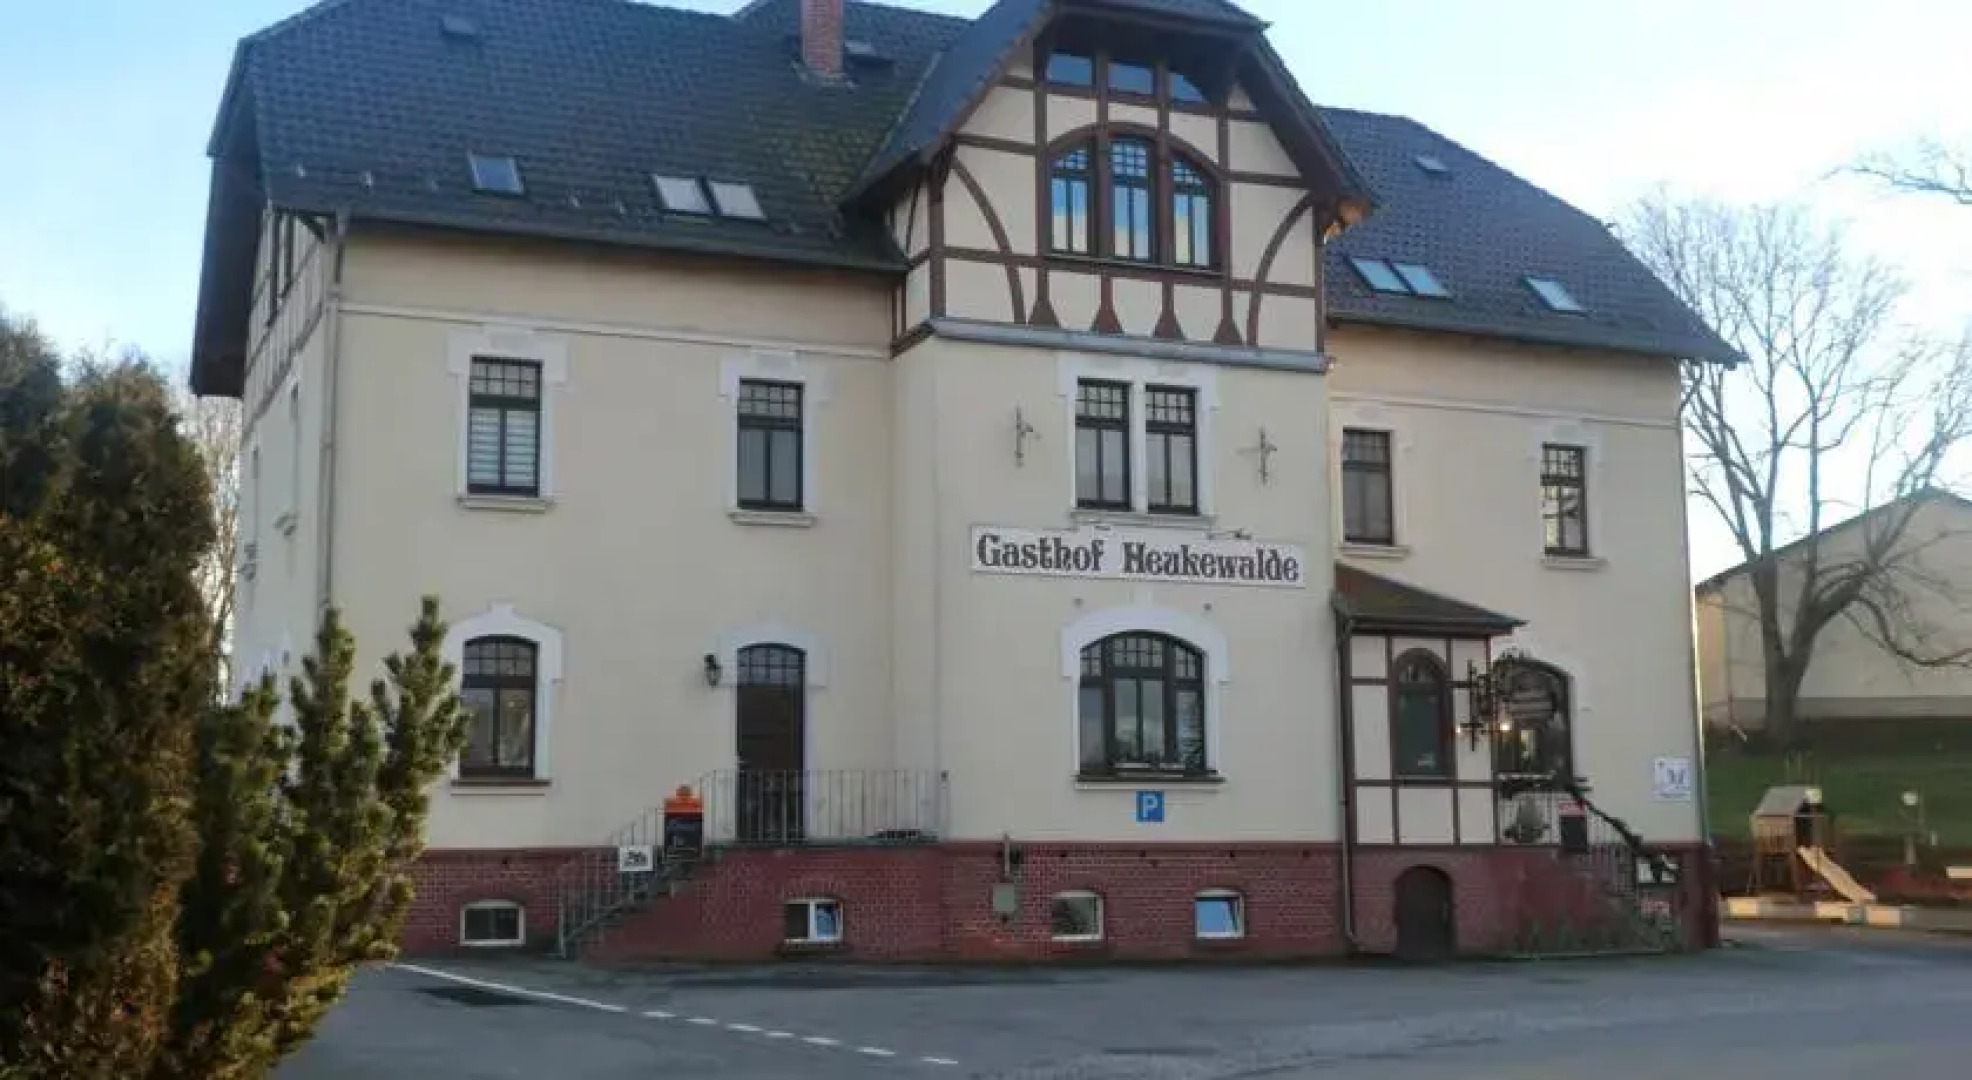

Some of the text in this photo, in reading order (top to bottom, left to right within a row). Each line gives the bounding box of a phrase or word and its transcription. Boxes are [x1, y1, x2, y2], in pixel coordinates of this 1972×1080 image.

[977, 533, 1299, 581] Gasthof Heukewalde
[1142, 794, 1159, 818] P
